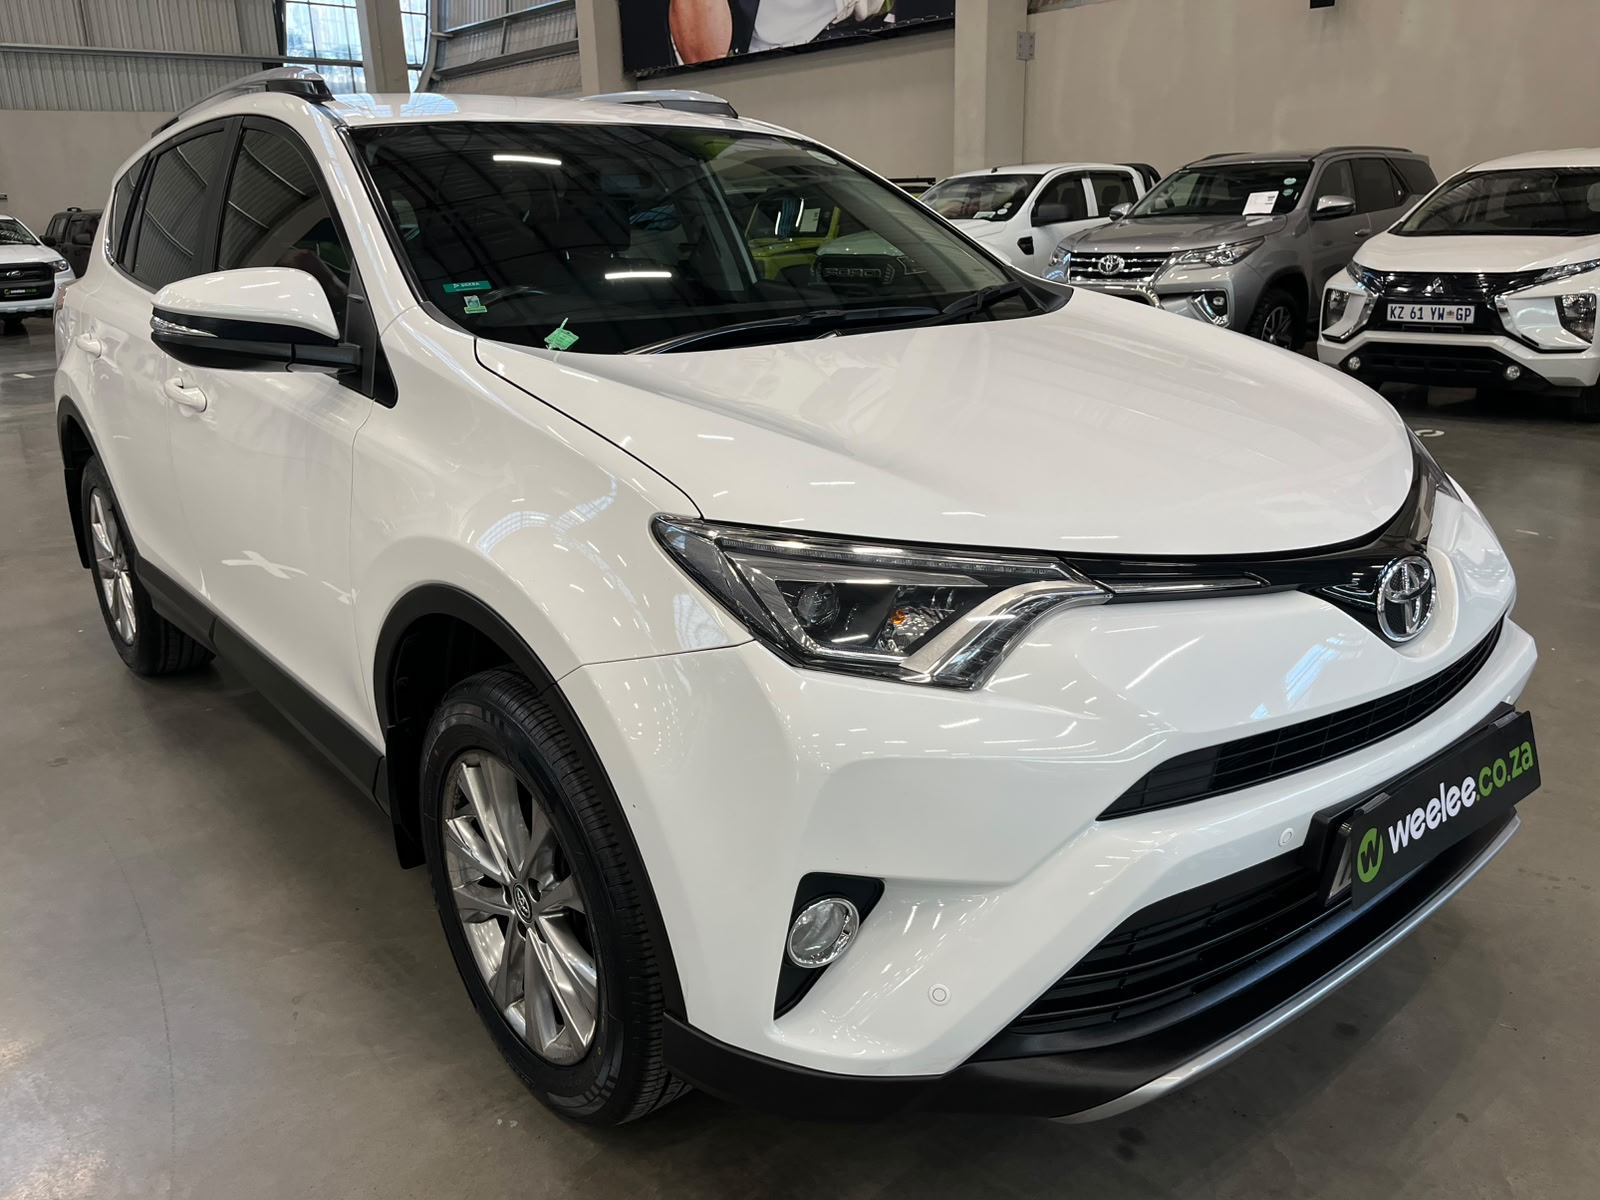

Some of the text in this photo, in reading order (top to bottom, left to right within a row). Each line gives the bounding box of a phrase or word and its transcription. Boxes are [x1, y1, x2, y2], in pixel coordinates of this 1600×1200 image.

[1389, 305, 1405, 320] KZ
[1409, 306, 1424, 321] 61
[1456, 307, 1472, 322] GP
[1388, 741, 1534, 854] weelee.co.za
